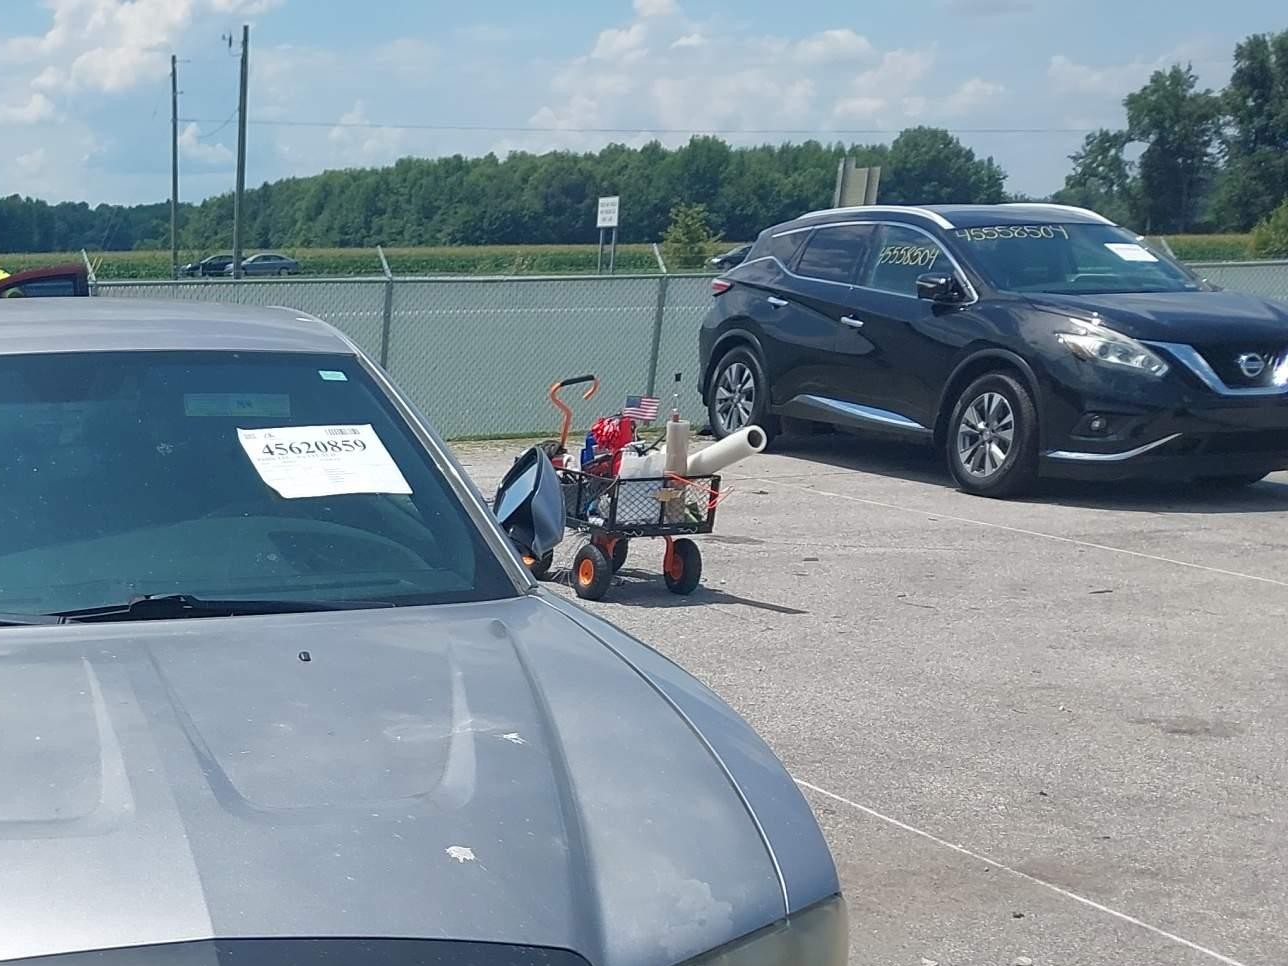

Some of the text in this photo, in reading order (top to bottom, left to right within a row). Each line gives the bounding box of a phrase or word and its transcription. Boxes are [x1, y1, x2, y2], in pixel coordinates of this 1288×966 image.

[955, 224, 1069, 241] 45558504
[878, 246, 939, 270] 45558504
[262, 439, 367, 456] 45620859
